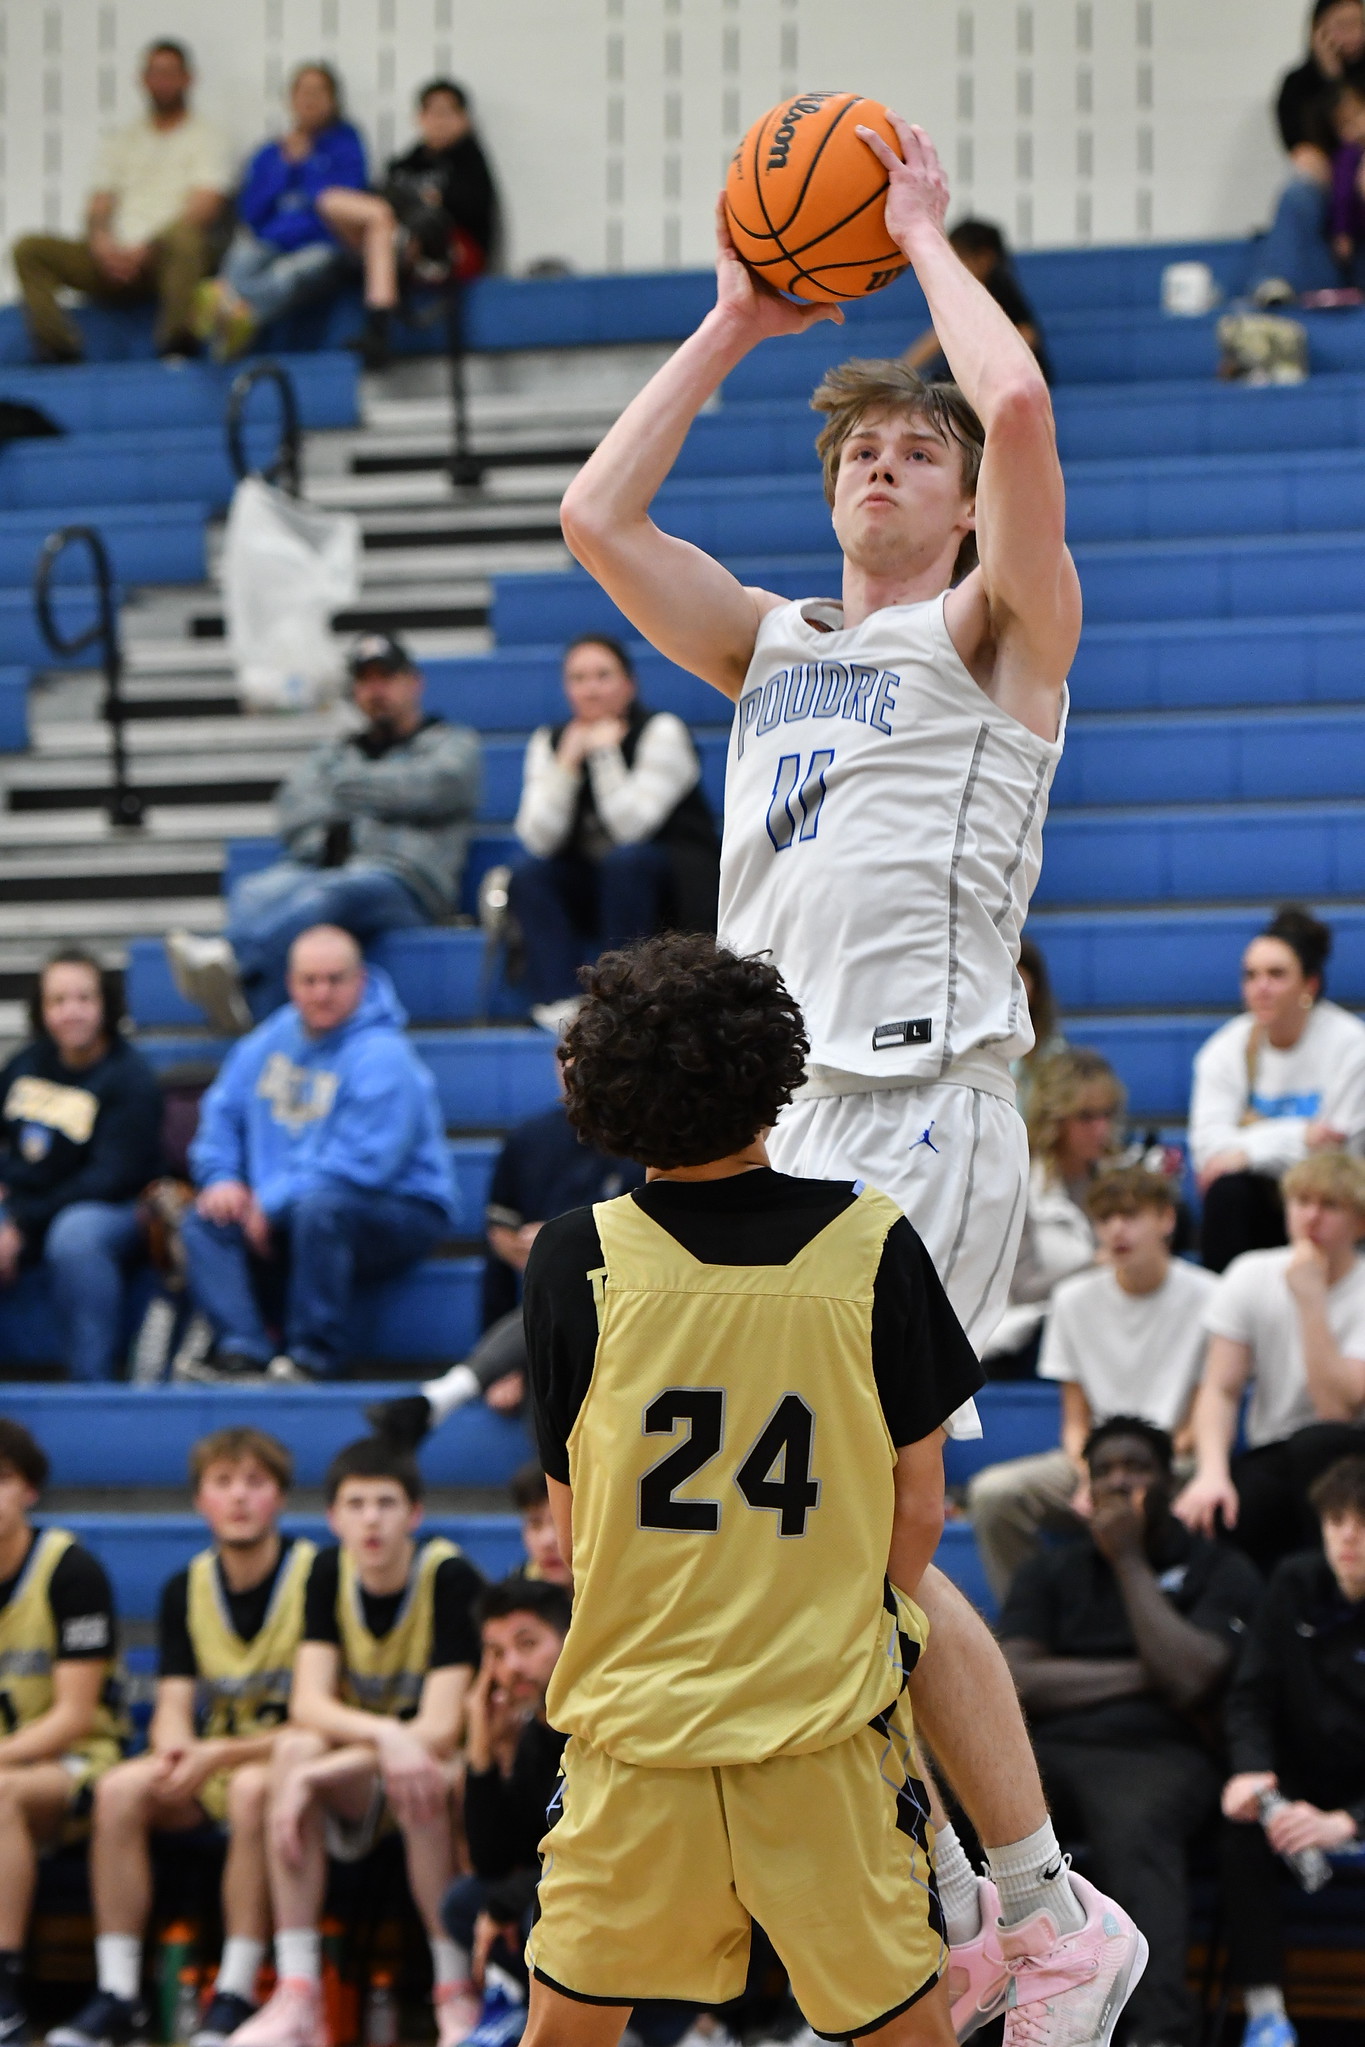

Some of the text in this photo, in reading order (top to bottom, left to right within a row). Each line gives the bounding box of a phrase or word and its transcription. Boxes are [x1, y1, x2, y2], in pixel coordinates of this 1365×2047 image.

[738, 661, 900, 761] POUDRE
[766, 749, 835, 852] 11
[637, 1386, 822, 1539] 24
